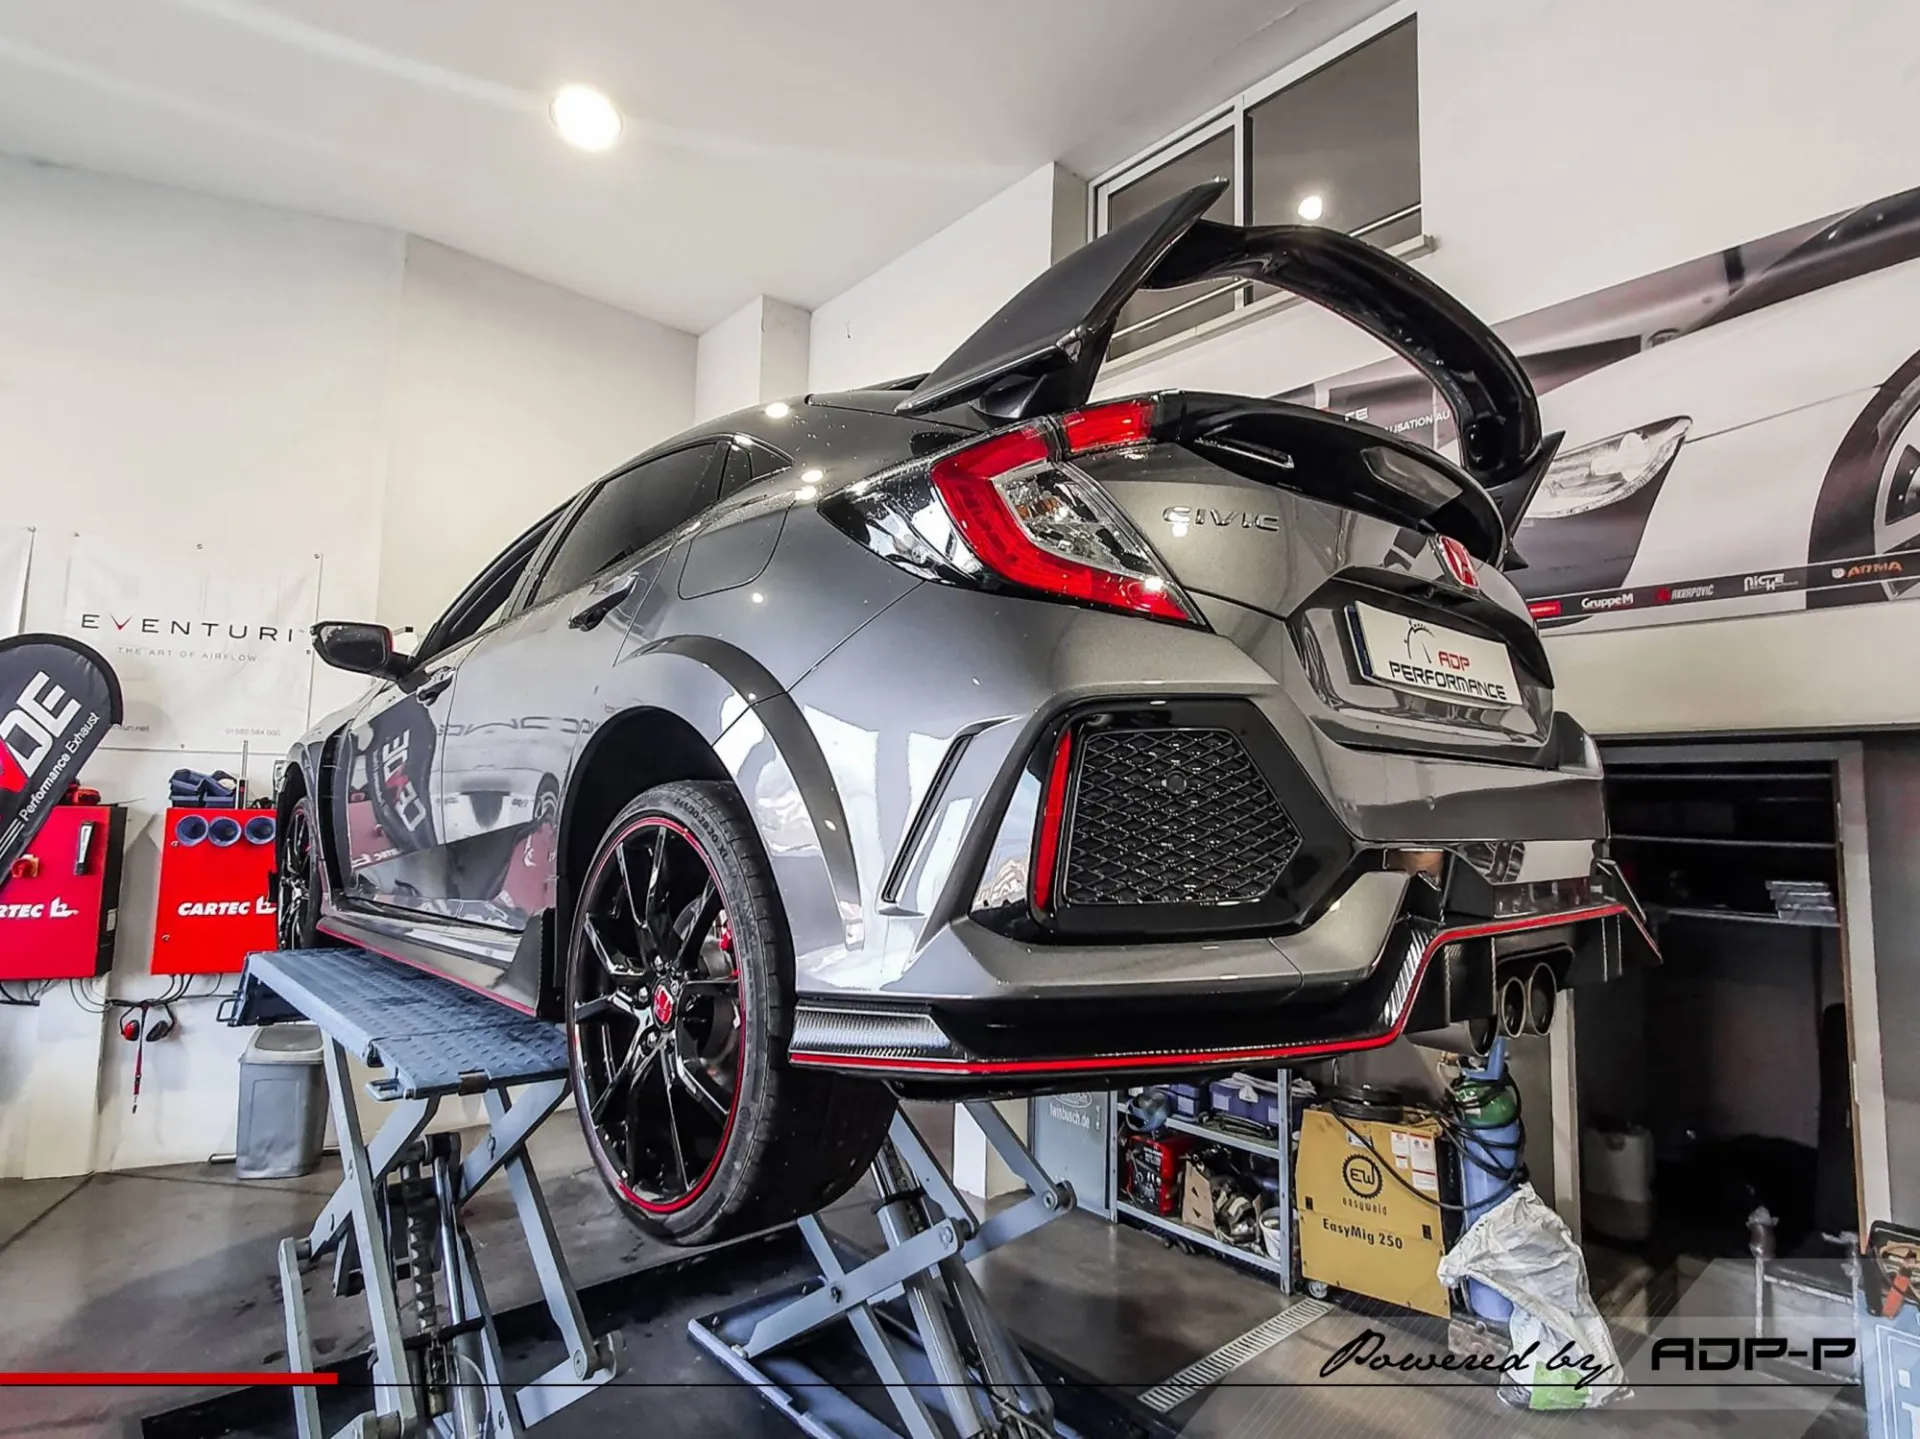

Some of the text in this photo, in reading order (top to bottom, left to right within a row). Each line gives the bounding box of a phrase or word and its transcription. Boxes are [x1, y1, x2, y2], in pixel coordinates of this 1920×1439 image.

[1162, 505, 1280, 532] CIVIC
[81, 612, 293, 642] EVENTURI
[119, 646, 258, 663] THE ART OF AIRFLOW
[1438, 650, 1471, 672] ADP
[1388, 660, 1508, 701] PERFORMANCE
[19, 711, 101, 822] Performance Exhaust
[177, 902, 250, 917] CARTEC
[1342, 1197, 1388, 1216] easyweld
[1323, 1218, 1404, 1250] EasyMig 250
